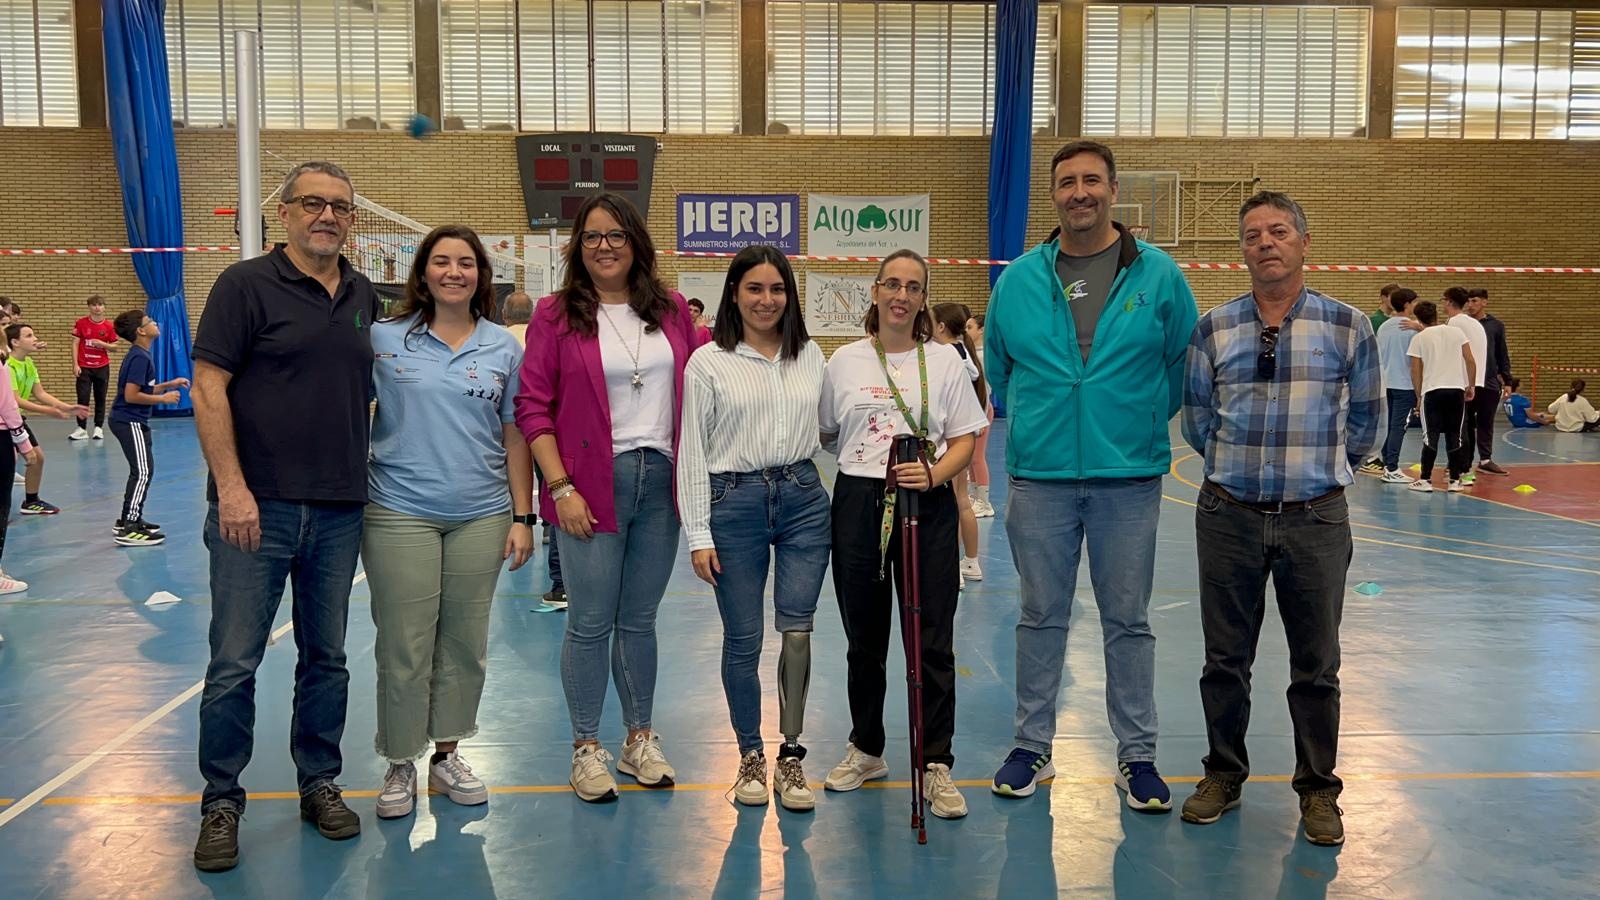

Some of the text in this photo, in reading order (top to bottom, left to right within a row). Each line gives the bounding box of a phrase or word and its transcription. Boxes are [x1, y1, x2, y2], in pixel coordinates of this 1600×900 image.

[540, 144, 562, 152] LOCAL
[604, 144, 636, 152] VISITANTE
[683, 201, 792, 239] HERBI
[683, 240, 729, 248] SUMINISTROS
